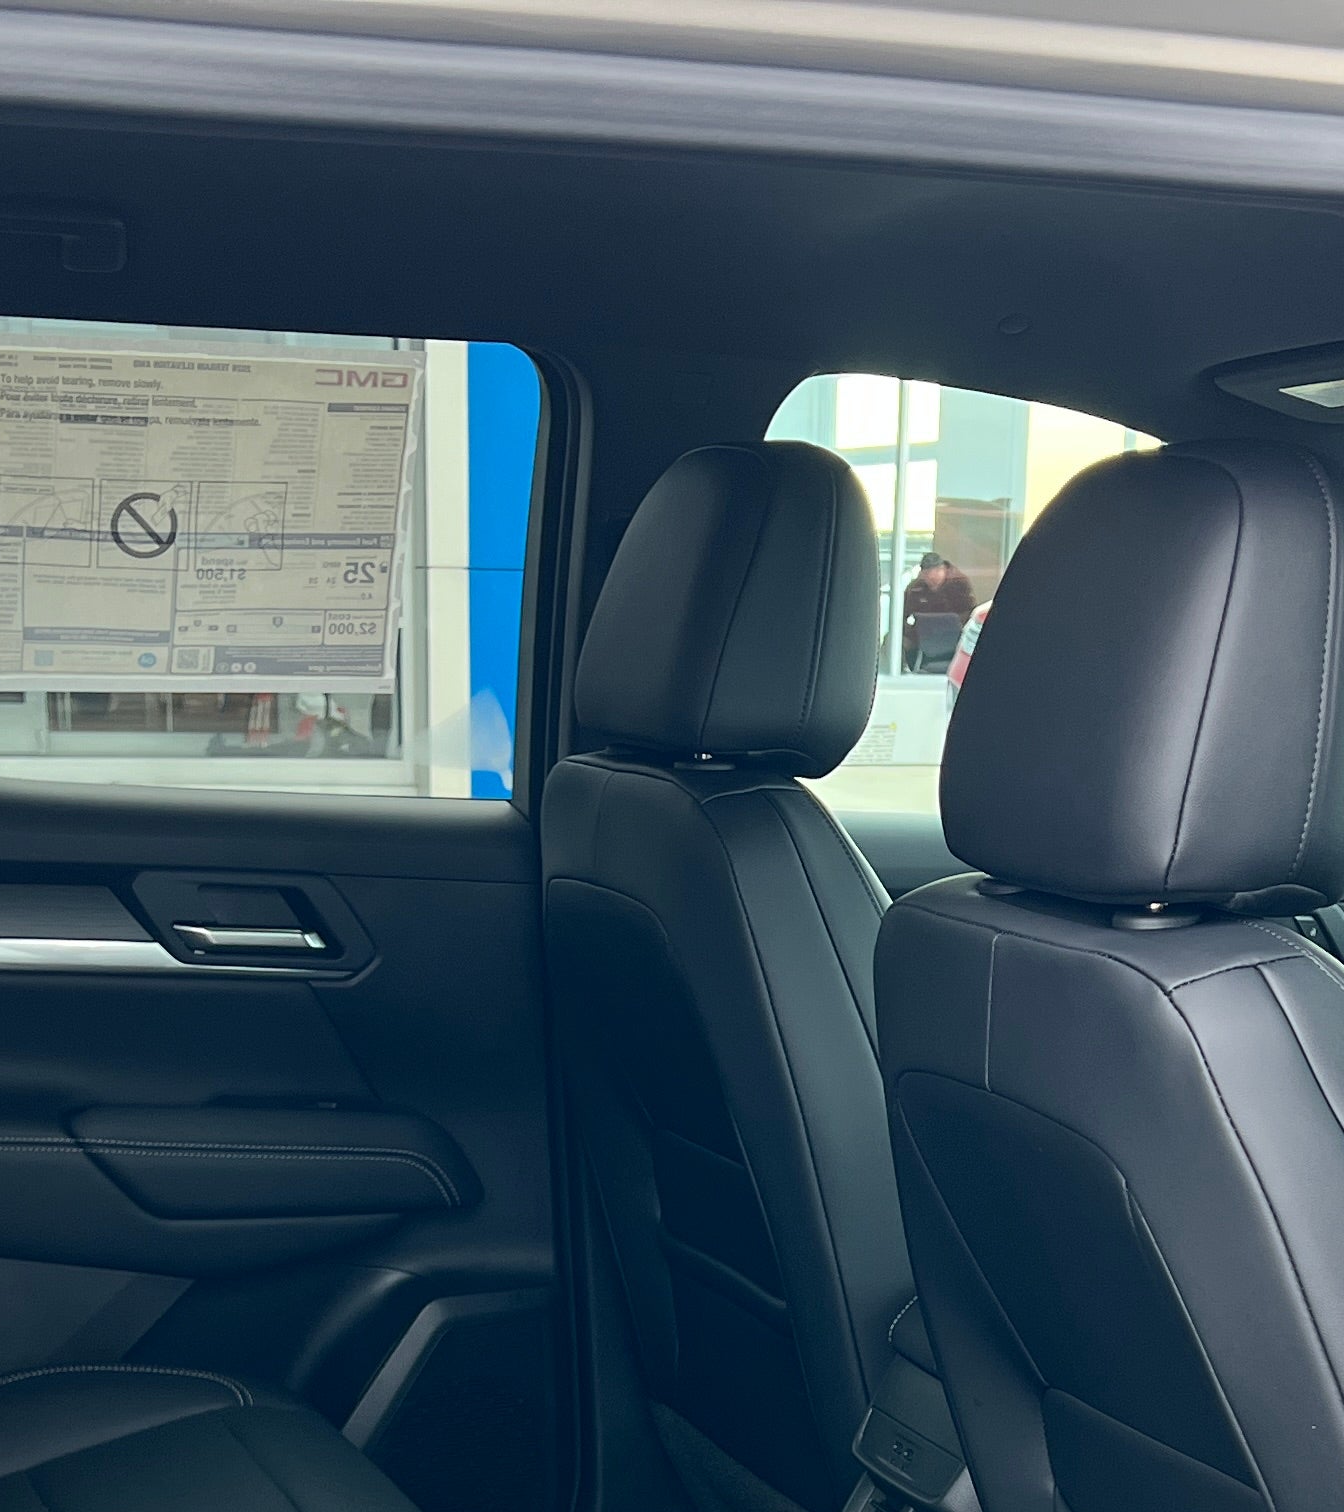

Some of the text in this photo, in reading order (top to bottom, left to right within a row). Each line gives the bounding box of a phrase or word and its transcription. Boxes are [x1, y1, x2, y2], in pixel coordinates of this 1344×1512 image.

[1, 373, 12, 384] To
[14, 375, 34, 386] help
[36, 376, 60, 385] avoid
[98, 379, 131, 388] remove
